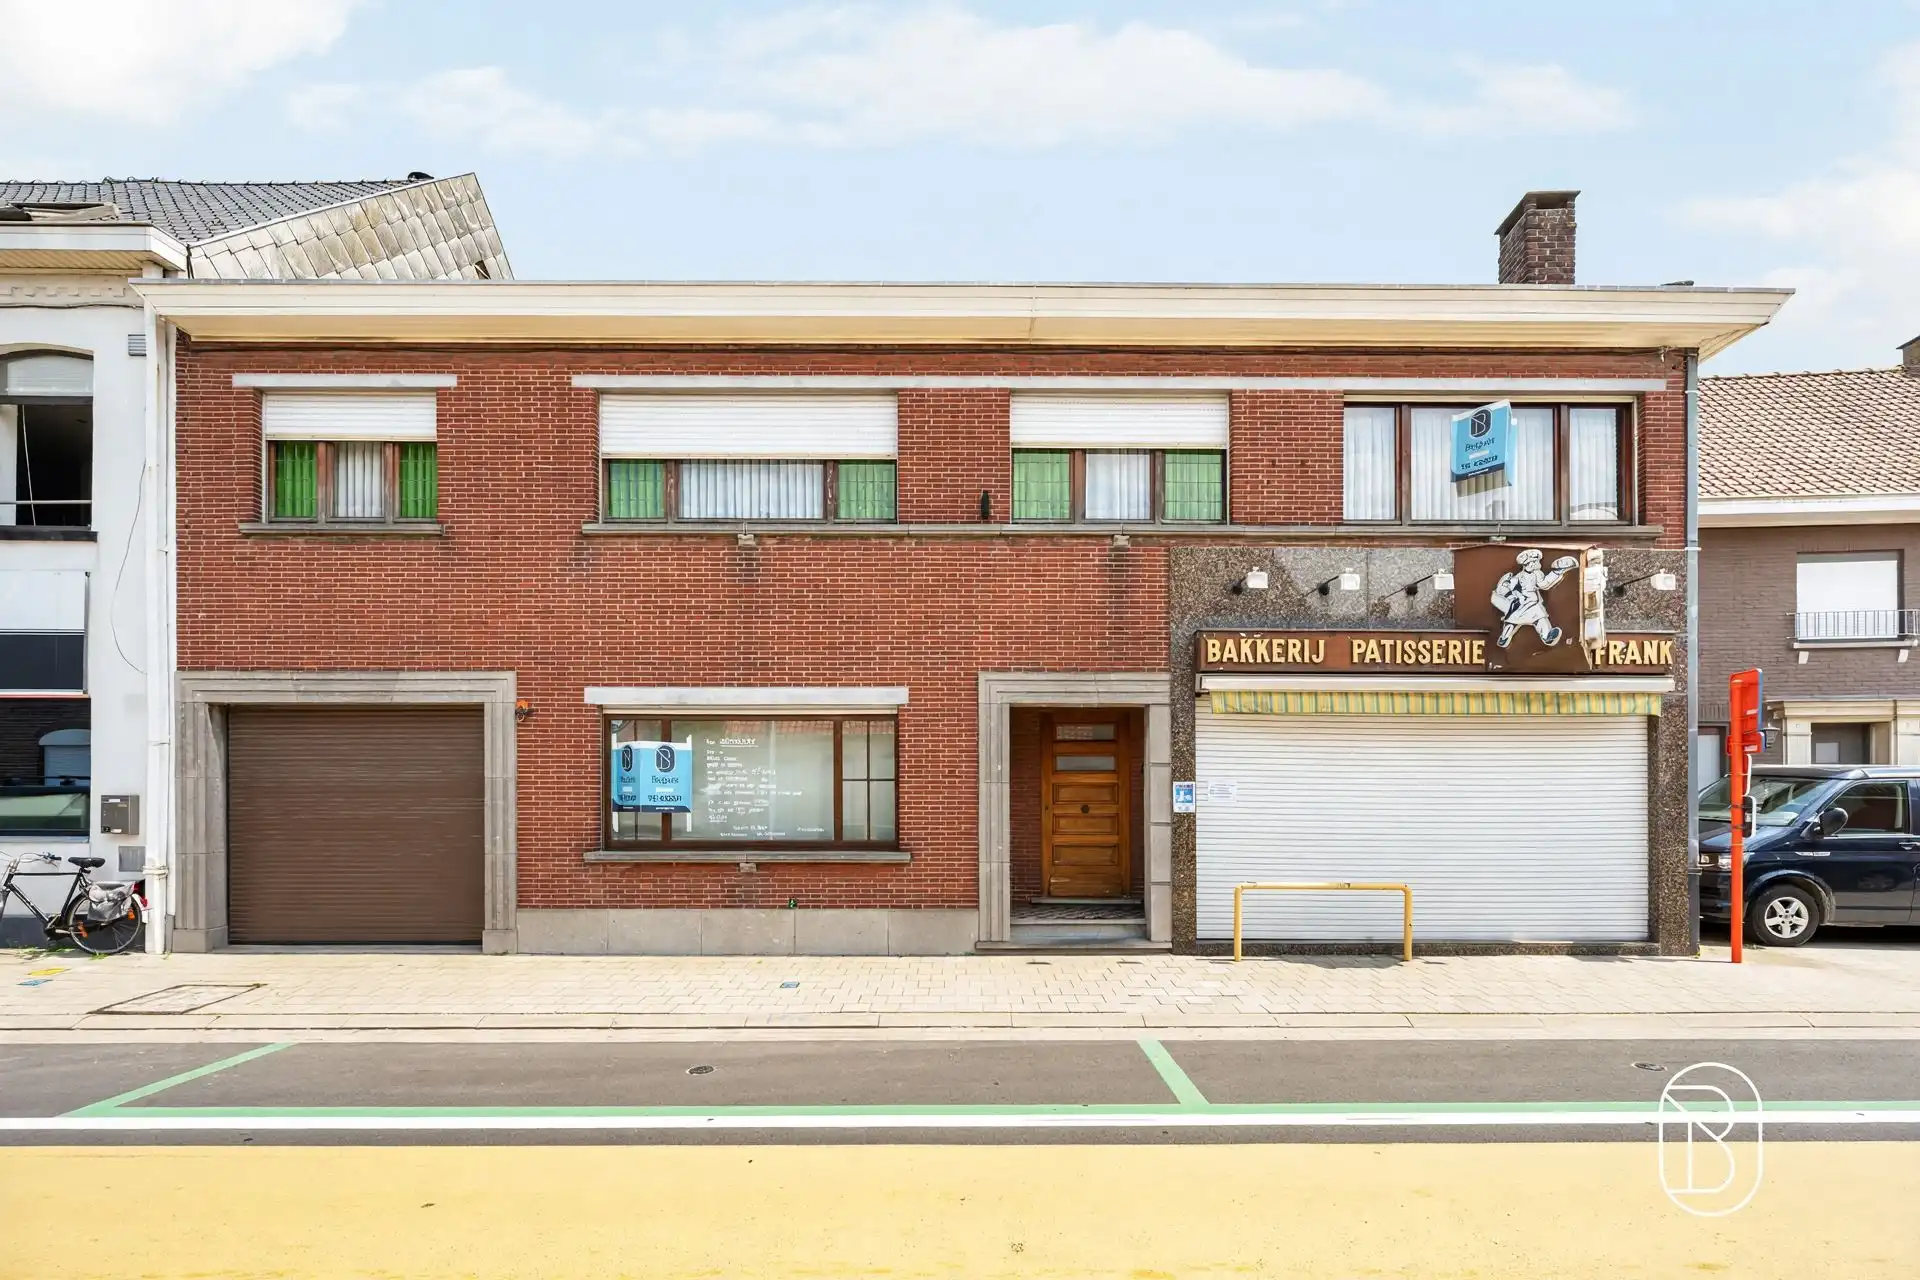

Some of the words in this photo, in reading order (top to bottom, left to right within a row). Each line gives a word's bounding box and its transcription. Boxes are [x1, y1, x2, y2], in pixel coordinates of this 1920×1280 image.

[1206, 638, 1325, 664] BAKKERIJ
[1351, 638, 1485, 665] PATISSERIE
[1594, 639, 1673, 665] FRANK
